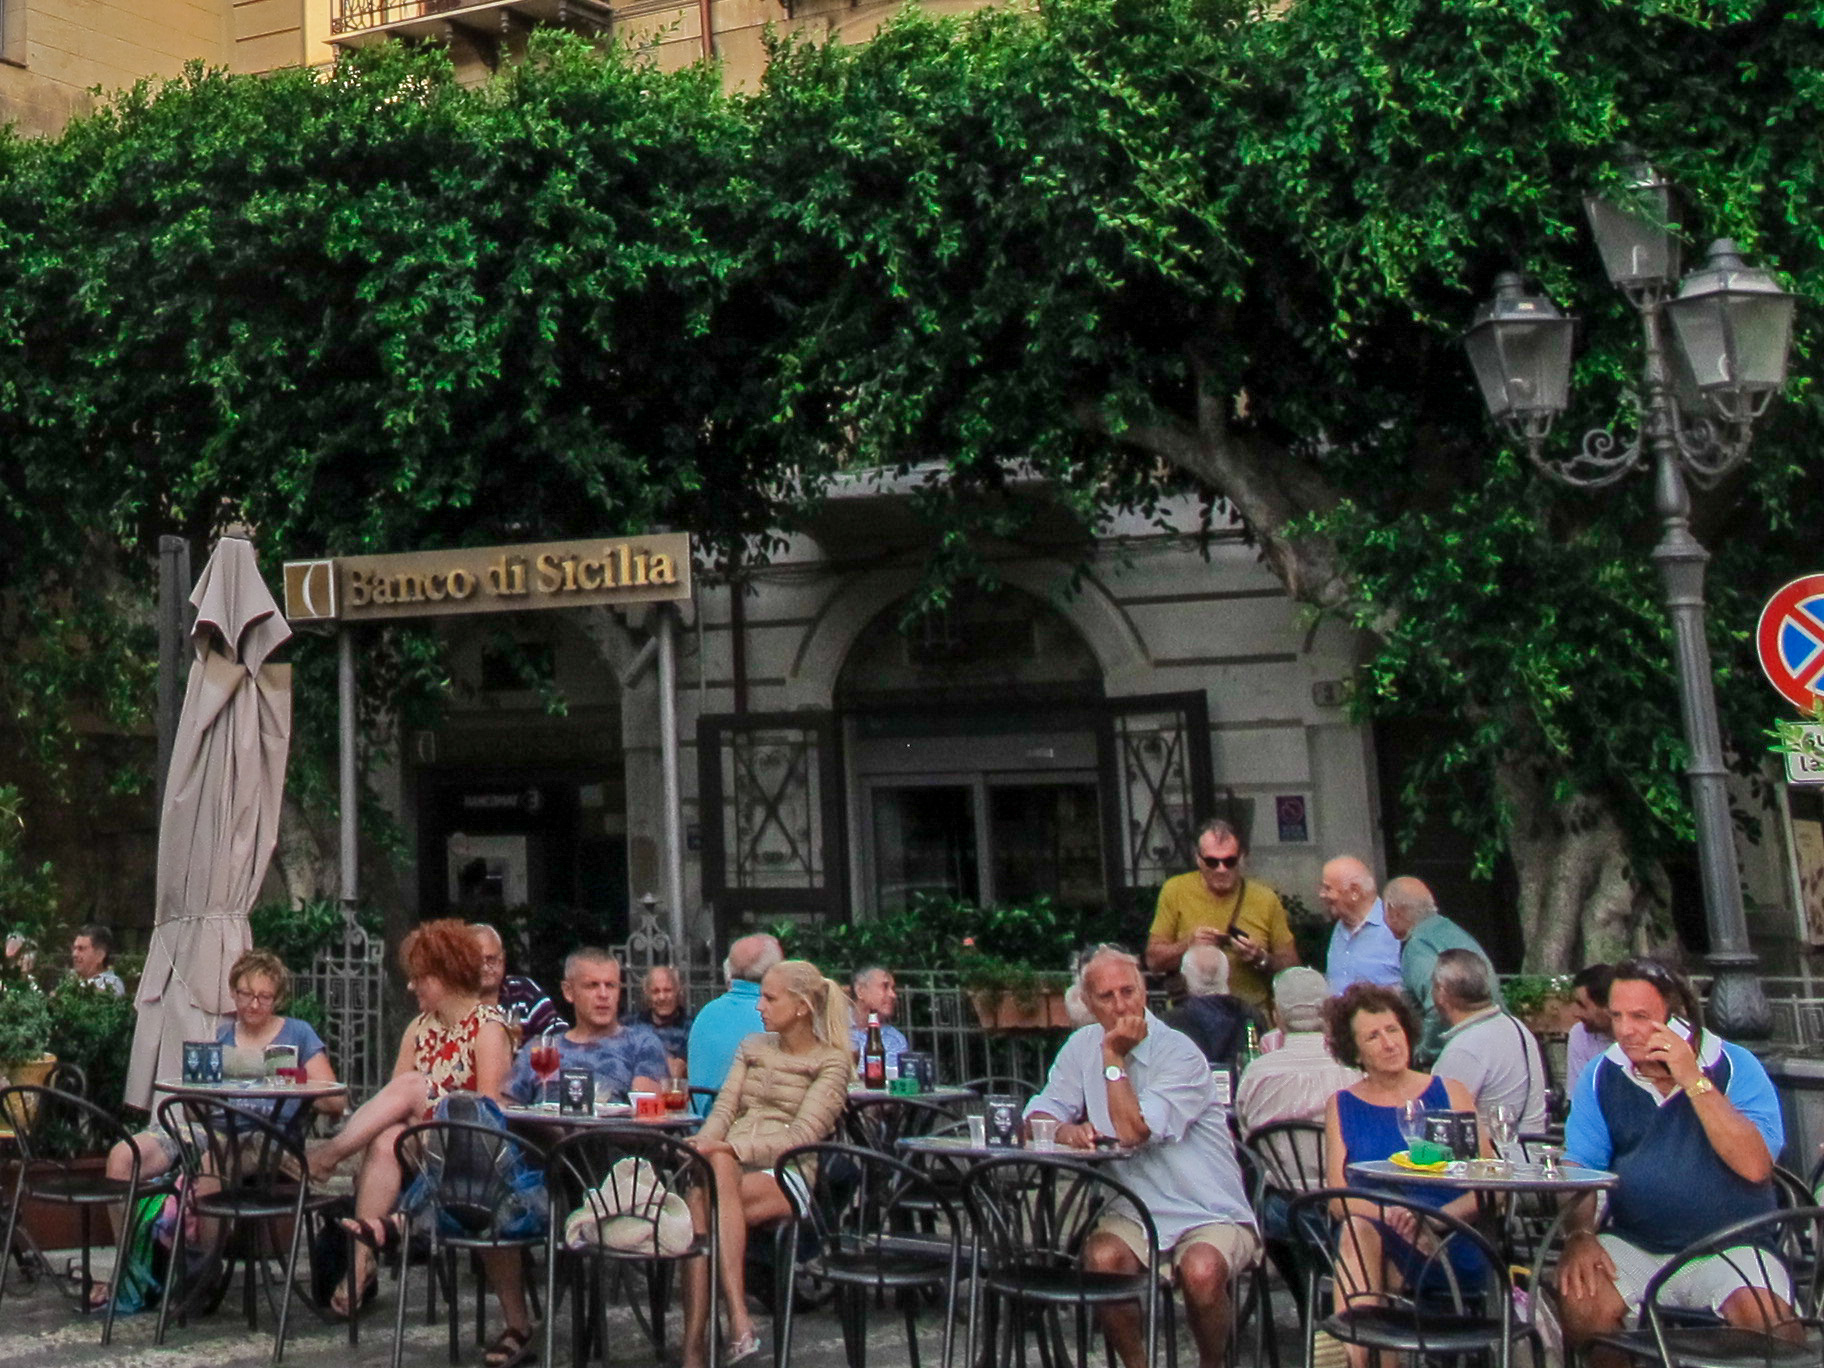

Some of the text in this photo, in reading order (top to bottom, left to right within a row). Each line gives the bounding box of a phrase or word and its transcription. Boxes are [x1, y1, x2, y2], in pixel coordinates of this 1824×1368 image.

[351, 543, 677, 607] Banco di Sicilia
